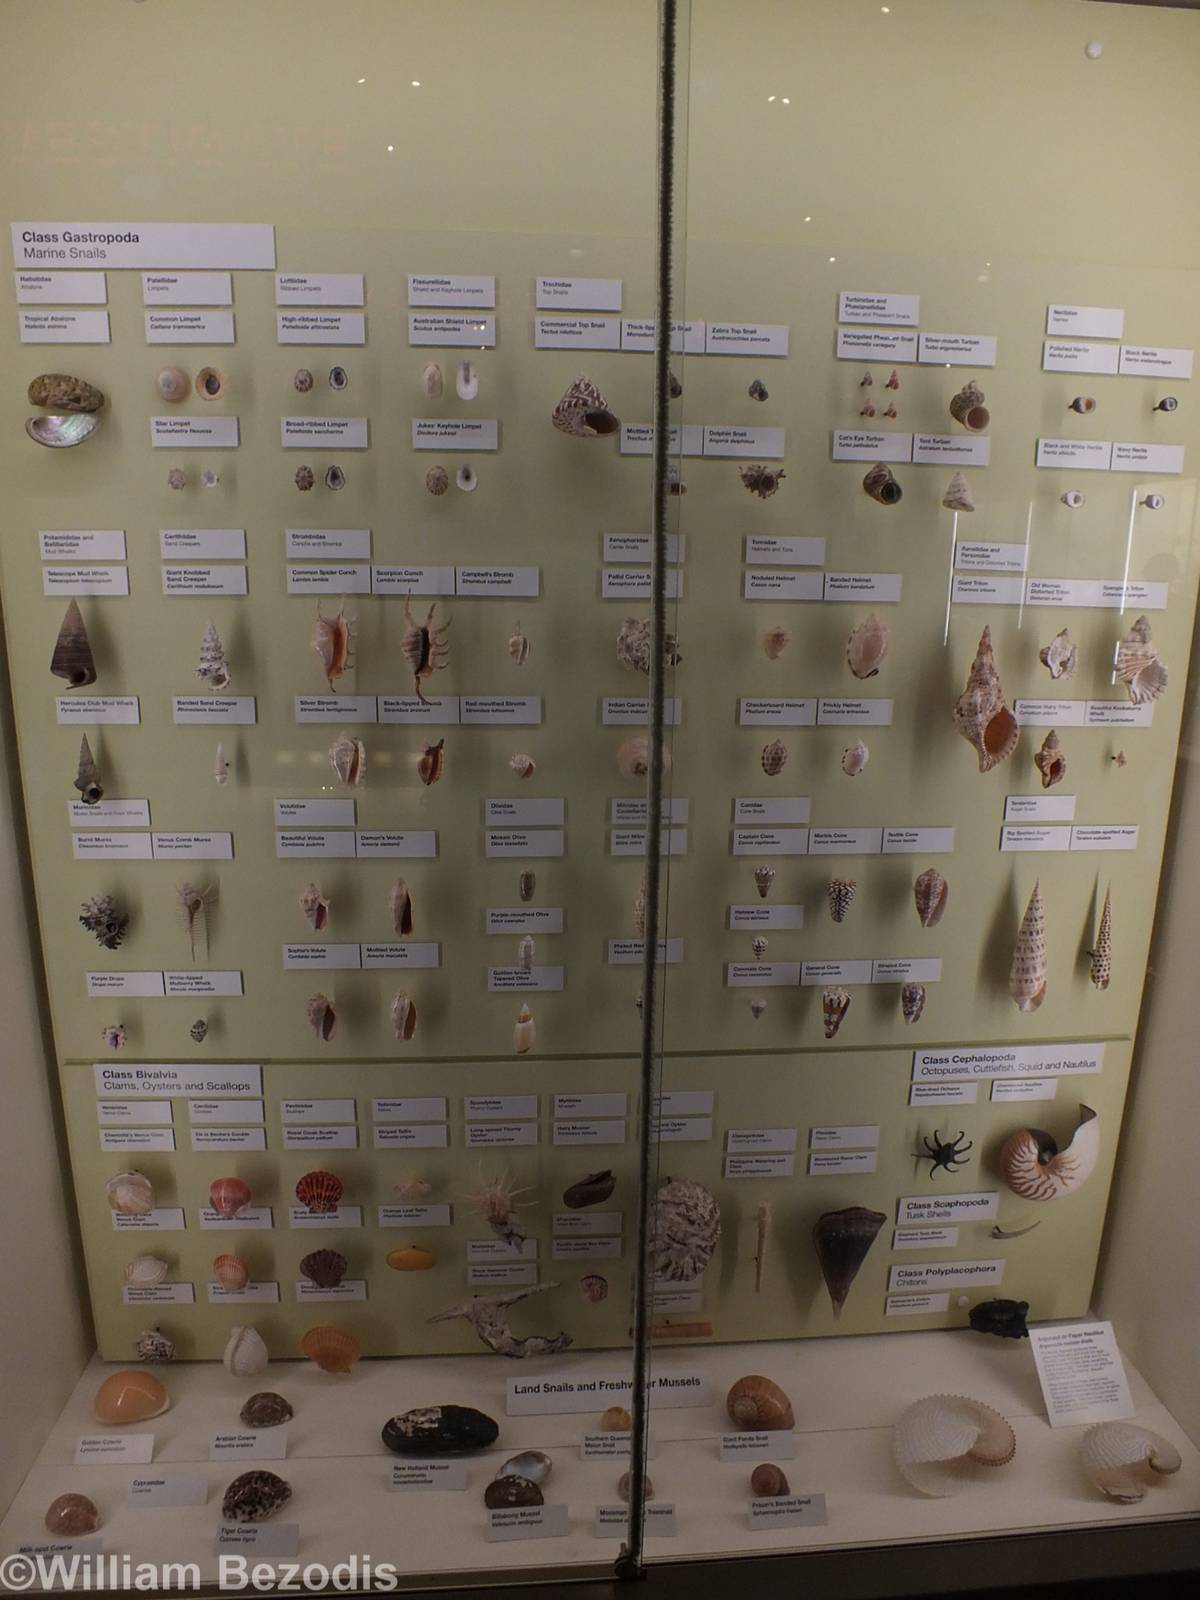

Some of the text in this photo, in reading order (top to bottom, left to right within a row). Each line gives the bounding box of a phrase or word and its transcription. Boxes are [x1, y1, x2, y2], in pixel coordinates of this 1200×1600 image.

[22, 232, 139, 244] Class Gastropoda
[24, 248, 106, 259] Marine Snails
[922, 1054, 1015, 1065] Class Cephalopoda
[921, 1059, 1096, 1076] Octopuses, Cuttlefish, Squid and Nautilus
[103, 1070, 177, 1079] Class Bivalvia
[104, 1081, 250, 1091] Clams, Oysters and Scallops
[907, 1198, 989, 1210] Class Scaphopoda
[906, 1210, 951, 1219] Tusk Shells
[898, 1265, 996, 1277] Class Polyplacophora
[896, 1278, 927, 1286] Chitons
[514, 1384, 540, 1394] Land
[543, 1382, 574, 1394] Snails
[577, 1382, 596, 1392] and
[660, 1377, 700, 1388] Mussels
